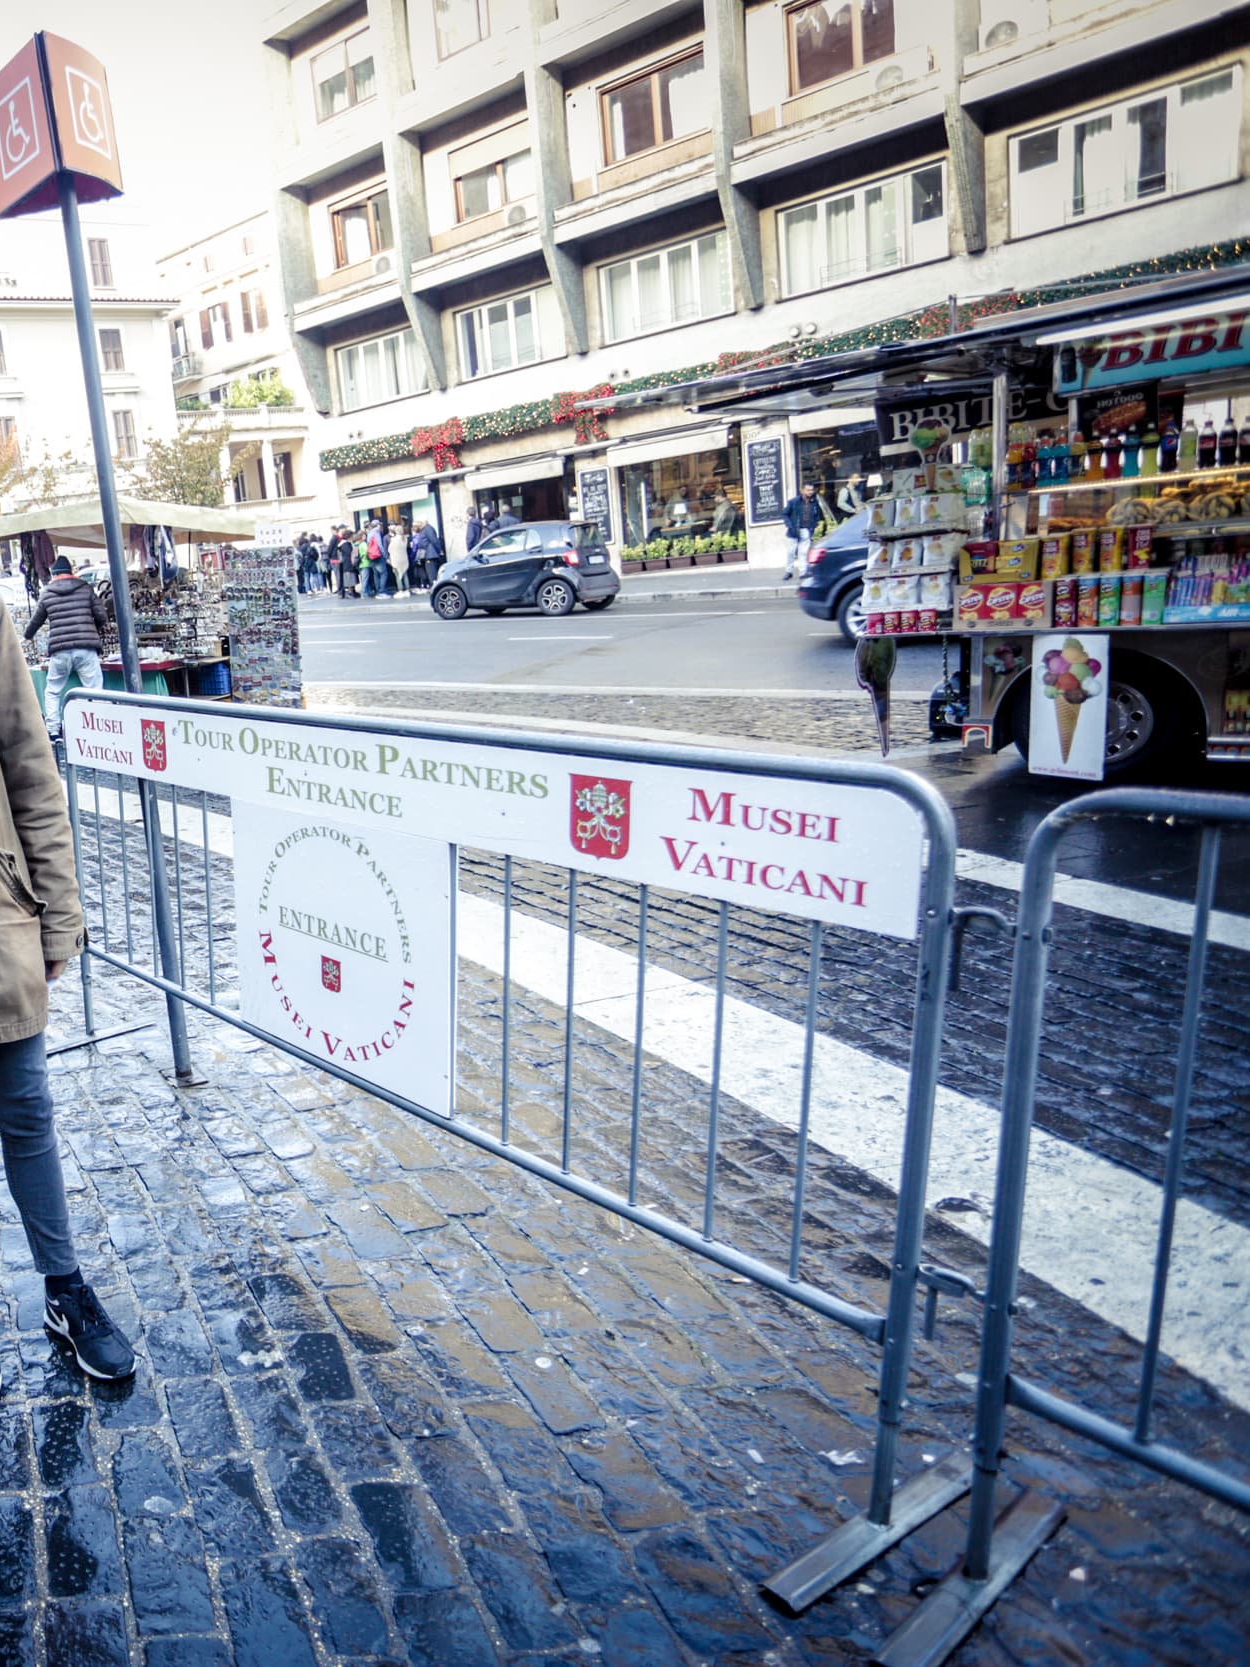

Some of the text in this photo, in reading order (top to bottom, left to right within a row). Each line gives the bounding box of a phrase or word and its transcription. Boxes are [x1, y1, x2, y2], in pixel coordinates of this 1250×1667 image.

[81, 711, 124, 734] MUSEI
[75, 738, 133, 766] VATICANI
[177, 719, 549, 799] TOUR OPERATOR PARTNERS
[265, 766, 403, 818] ENTRANCE
[686, 787, 842, 843] MUSEI
[258, 825, 412, 965] TOUR OPERATOR PARTNERS
[658, 835, 869, 908] VATICANI
[278, 905, 387, 959] ENTRANCE
[258, 928, 415, 1062] MUSEI VATICANI
